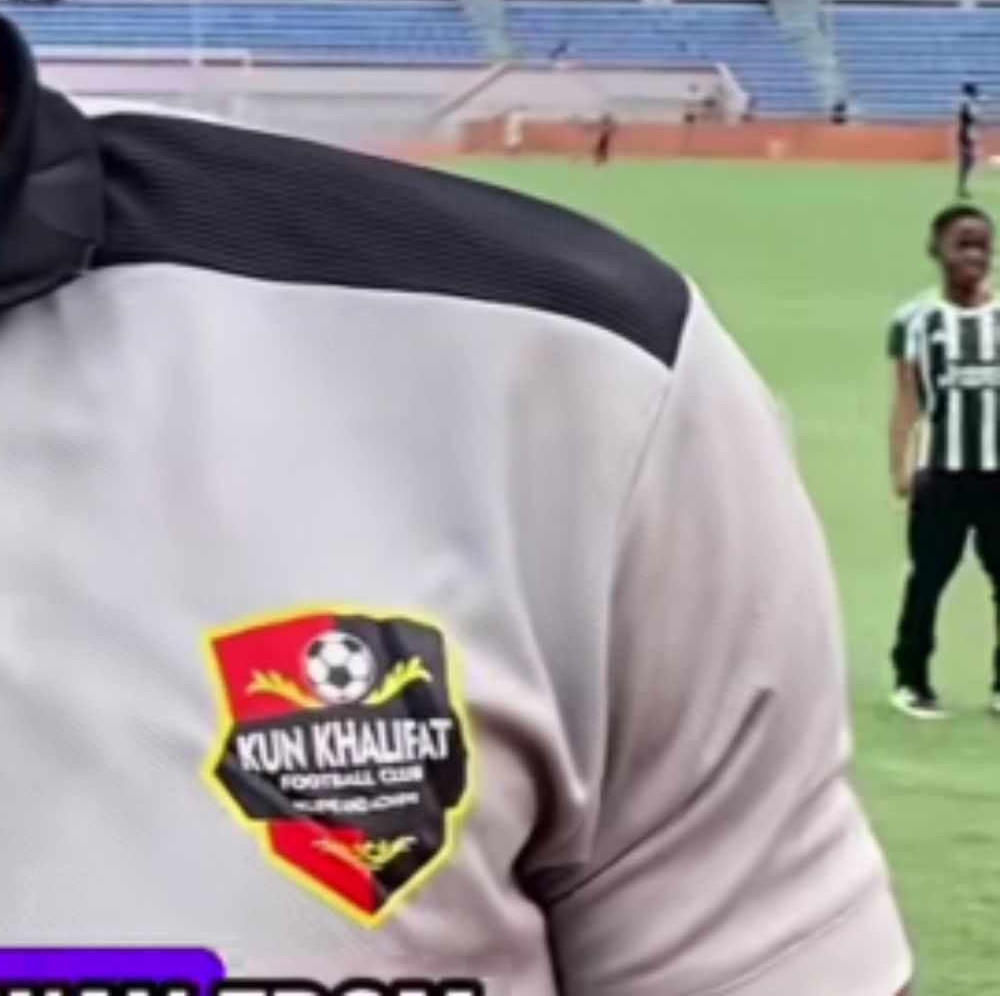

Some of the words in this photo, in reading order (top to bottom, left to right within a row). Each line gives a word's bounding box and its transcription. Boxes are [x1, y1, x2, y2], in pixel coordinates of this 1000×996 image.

[236, 724, 306, 771] KUN
[311, 718, 452, 769] KHALIFAT
[280, 769, 376, 790] FOOTBALL
[379, 765, 422, 783] CLUB
